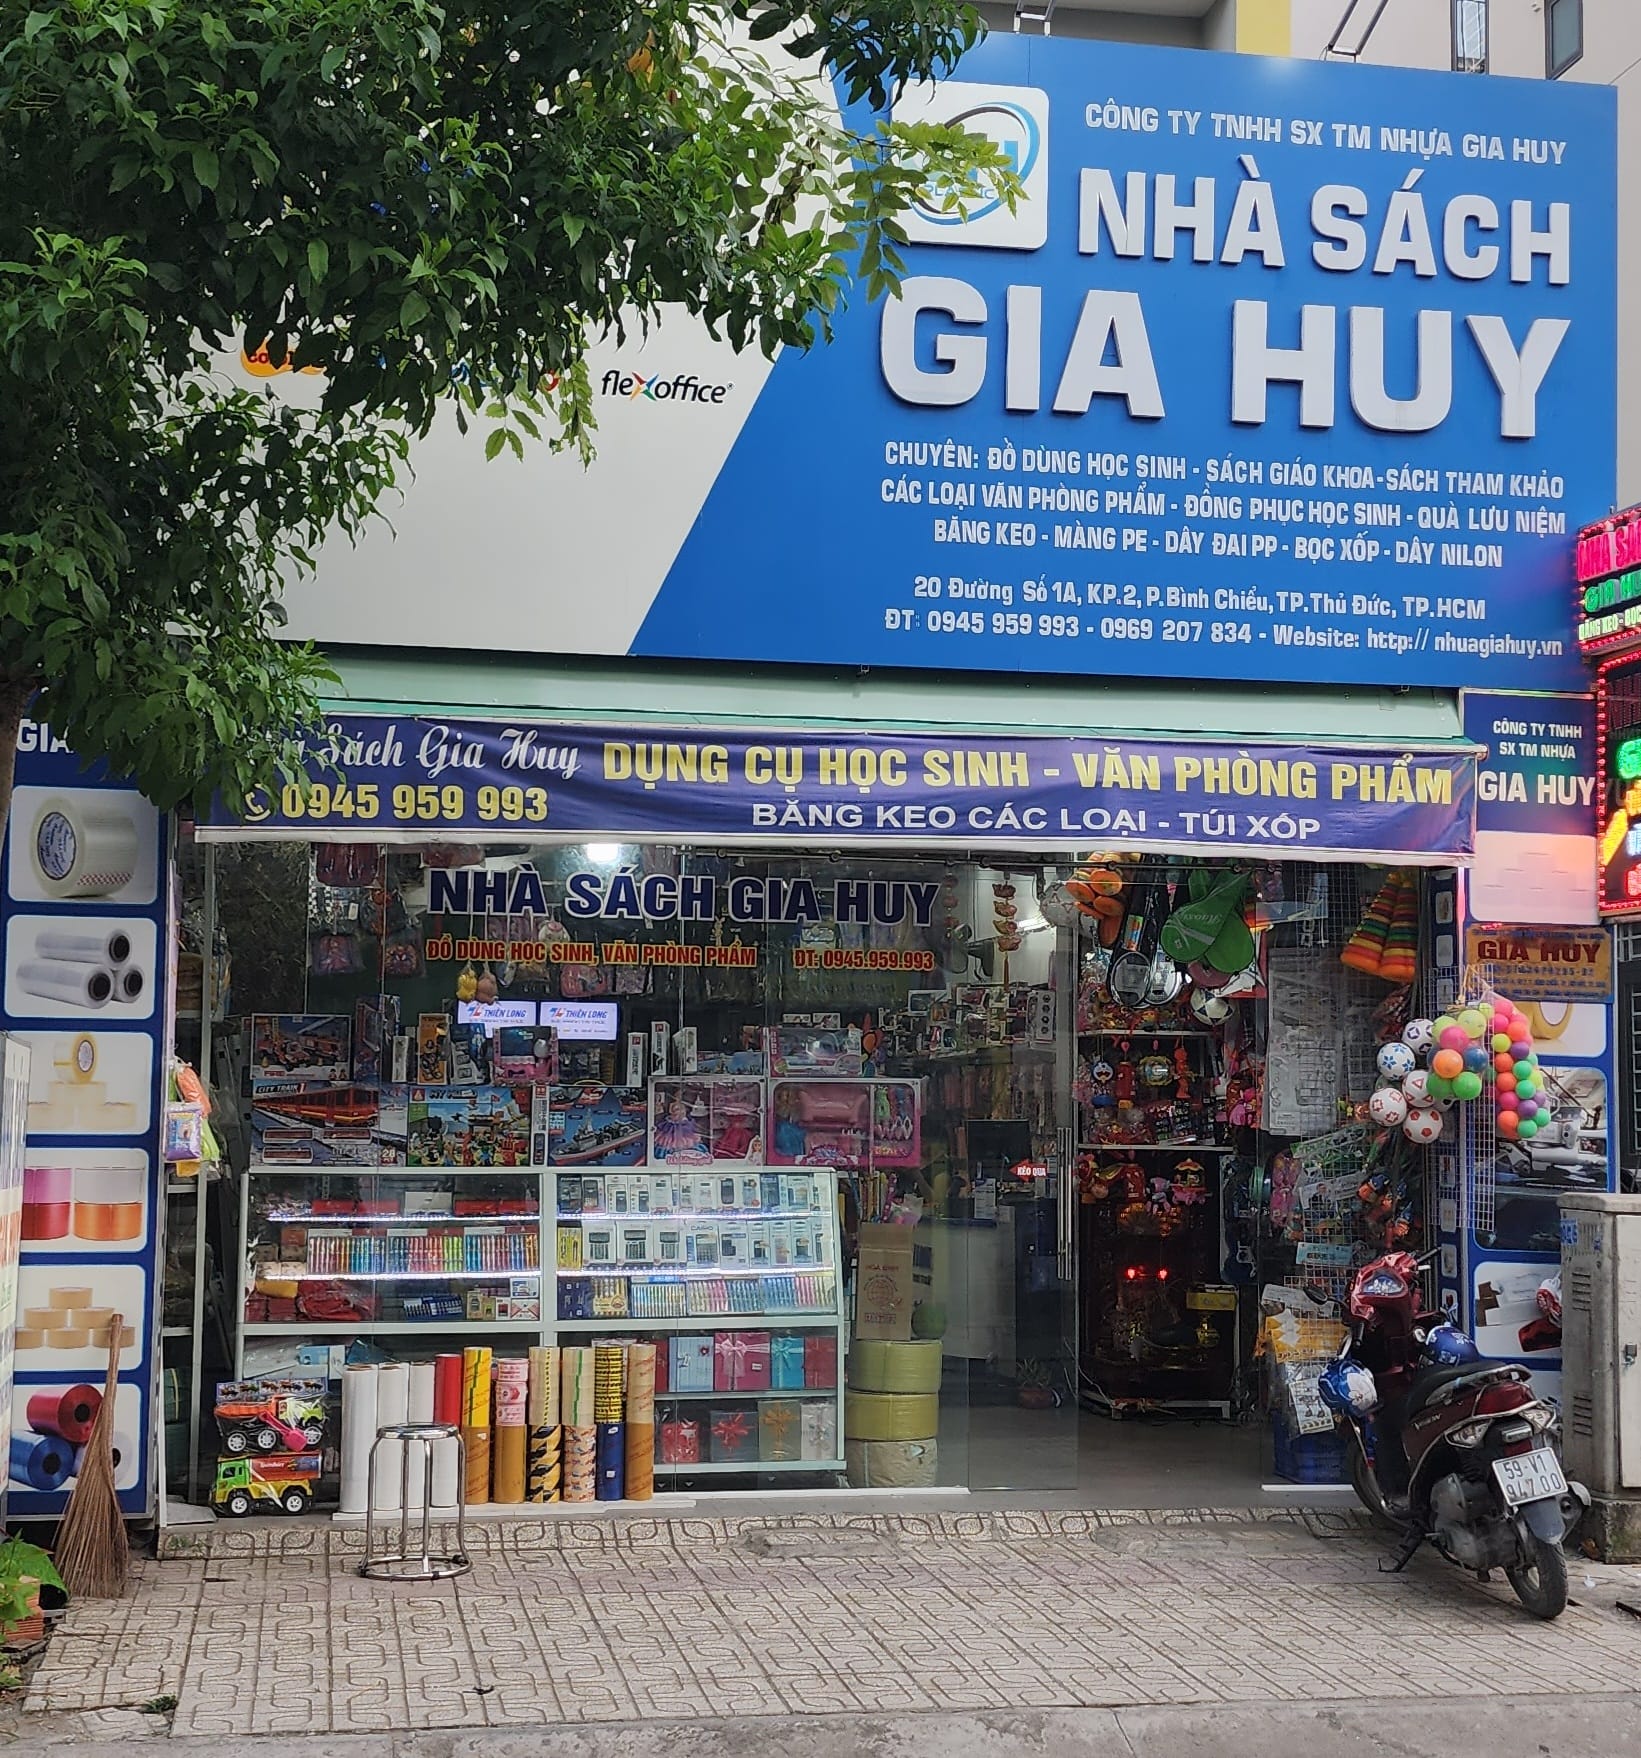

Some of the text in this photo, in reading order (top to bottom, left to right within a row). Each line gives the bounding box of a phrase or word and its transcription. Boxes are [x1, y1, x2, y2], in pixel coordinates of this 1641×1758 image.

[1085, 98, 1566, 165] CÔNG TY TNHH SX TM NHỰA GIA HUY
[1078, 154, 1570, 285] NHÀ SÁCH
[880, 275, 1571, 438] GIA HUY
[885, 438, 980, 468] CHUYÊN:
[988, 437, 1016, 471] ĐỒ
[1022, 444, 1081, 474] DÙNG
[1088, 452, 1129, 480] HỌC
[1136, 454, 1186, 480] SINH
[1206, 452, 1263, 484] SÁCH
[1270, 456, 1317, 487] GIÁO
[1446, 471, 1504, 496] THAM
[1510, 470, 1564, 499] KHẢO
[881, 474, 922, 504] CÁC
[928, 482, 976, 511] LOẠI
[982, 482, 1023, 510] VĂN
[1028, 482, 1099, 513] PHÒNG
[1105, 481, 1166, 516] PHẨM
[1184, 483, 1242, 520] ĐỒNG
[1250, 498, 1304, 526] PHỤC
[1308, 502, 1348, 528] HỌC
[1354, 502, 1401, 527] SINH
[1418, 500, 1460, 530] QUÀ
[1468, 506, 1509, 532] LƯU
[1515, 506, 1566, 539] NIỆM
[934, 516, 990, 545] BĂNG
[996, 522, 1036, 547] KEO
[1054, 520, 1116, 551] MÀNG
[1122, 528, 1148, 552] PE
[1166, 526, 1206, 556] DÂY
[1212, 532, 1248, 558] ĐAI
[1251, 535, 1278, 558] PP
[1294, 536, 1335, 565] BỌC
[1340, 530, 1380, 562] XỐP
[1395, 536, 1435, 565] DÂY
[1441, 542, 1503, 568] NILON
[914, 576, 942, 598] 20
[948, 577, 1014, 607] Đường
[1022, 572, 1048, 602] Số
[1052, 581, 1082, 607] 1A,
[1087, 582, 1142, 609] KP.2,
[1352, 592, 1398, 620] Đức,
[1402, 596, 1486, 620] TP.HCM
[926, 610, 985, 634] 0945
[992, 612, 1032, 636] 959
[1038, 614, 1080, 638] 993
[1100, 617, 1153, 640] 0969
[1162, 620, 1203, 643] 207
[1210, 622, 1252, 644] 834
[1272, 624, 1360, 648] Website:
[1434, 632, 1564, 660] nhuagiahuy.vn
[1493, 718, 1582, 740] CÔNG TY TNHH
[1499, 742, 1576, 762] SX TM NHỰA
[416, 724, 486, 779] Gia
[499, 728, 582, 780] Huy
[604, 742, 729, 791] DỤNG
[743, 744, 804, 792] CỤ
[818, 746, 908, 795] HỌC
[922, 749, 1030, 788] SINH
[1071, 746, 1162, 792] VĂN
[1174, 750, 1318, 800] PHÒNG
[1331, 752, 1453, 805] PHẨM
[1478, 770, 1596, 806] GIA HUY
[282, 783, 380, 819] 0945
[392, 784, 464, 821] 959
[477, 786, 548, 822] 993
[752, 802, 863, 829] BĂNG
[876, 804, 954, 830] KEO
[966, 800, 1048, 832] CÁC
[1060, 807, 1146, 838] LOẠI
[1178, 808, 1236, 836] TÚI
[426, 864, 940, 928] NHÀ SÁCH GIA HUY
[426, 933, 935, 972] ĐỒ DÙNG HỌC SINH, VĂN PHÒNG PHẨM ĐT: 0945.959.993
[1478, 940, 1600, 963] GIA HUY
[506, 1009, 526, 1018] LONG
[588, 1009, 608, 1018] LONG
[1032, 1167, 1046, 1176] QUA
